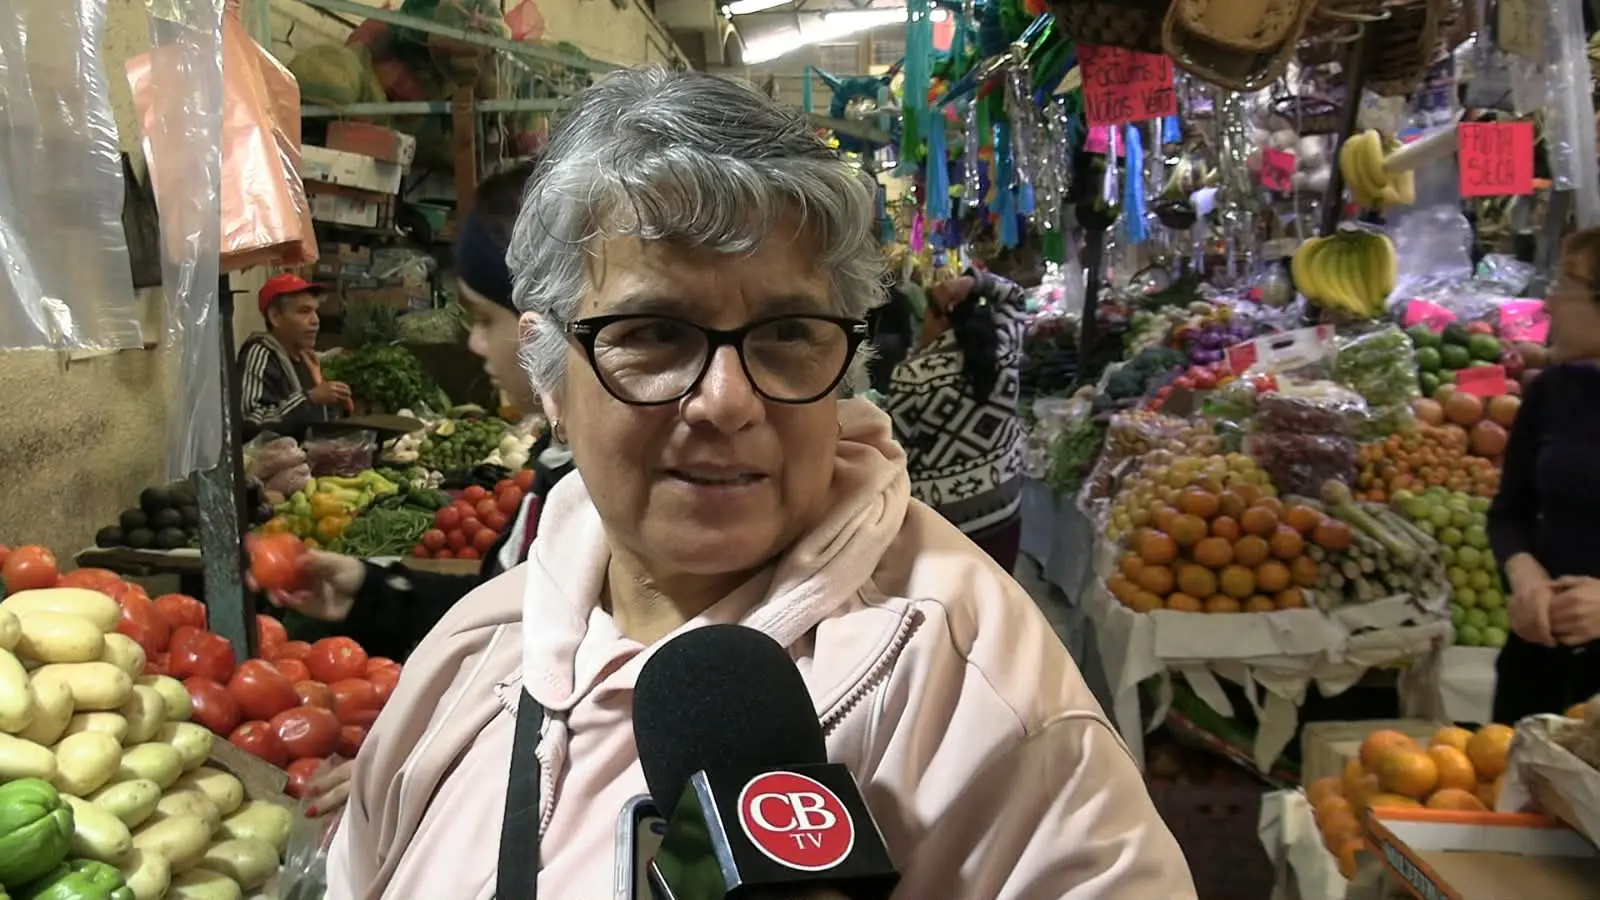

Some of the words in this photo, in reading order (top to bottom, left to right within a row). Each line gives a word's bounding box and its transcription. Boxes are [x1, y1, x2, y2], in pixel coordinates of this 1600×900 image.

[1086, 88, 1133, 121] Notas
[1468, 157, 1515, 187] SECA
[750, 792, 836, 831] CB
[789, 832, 822, 850] TV
